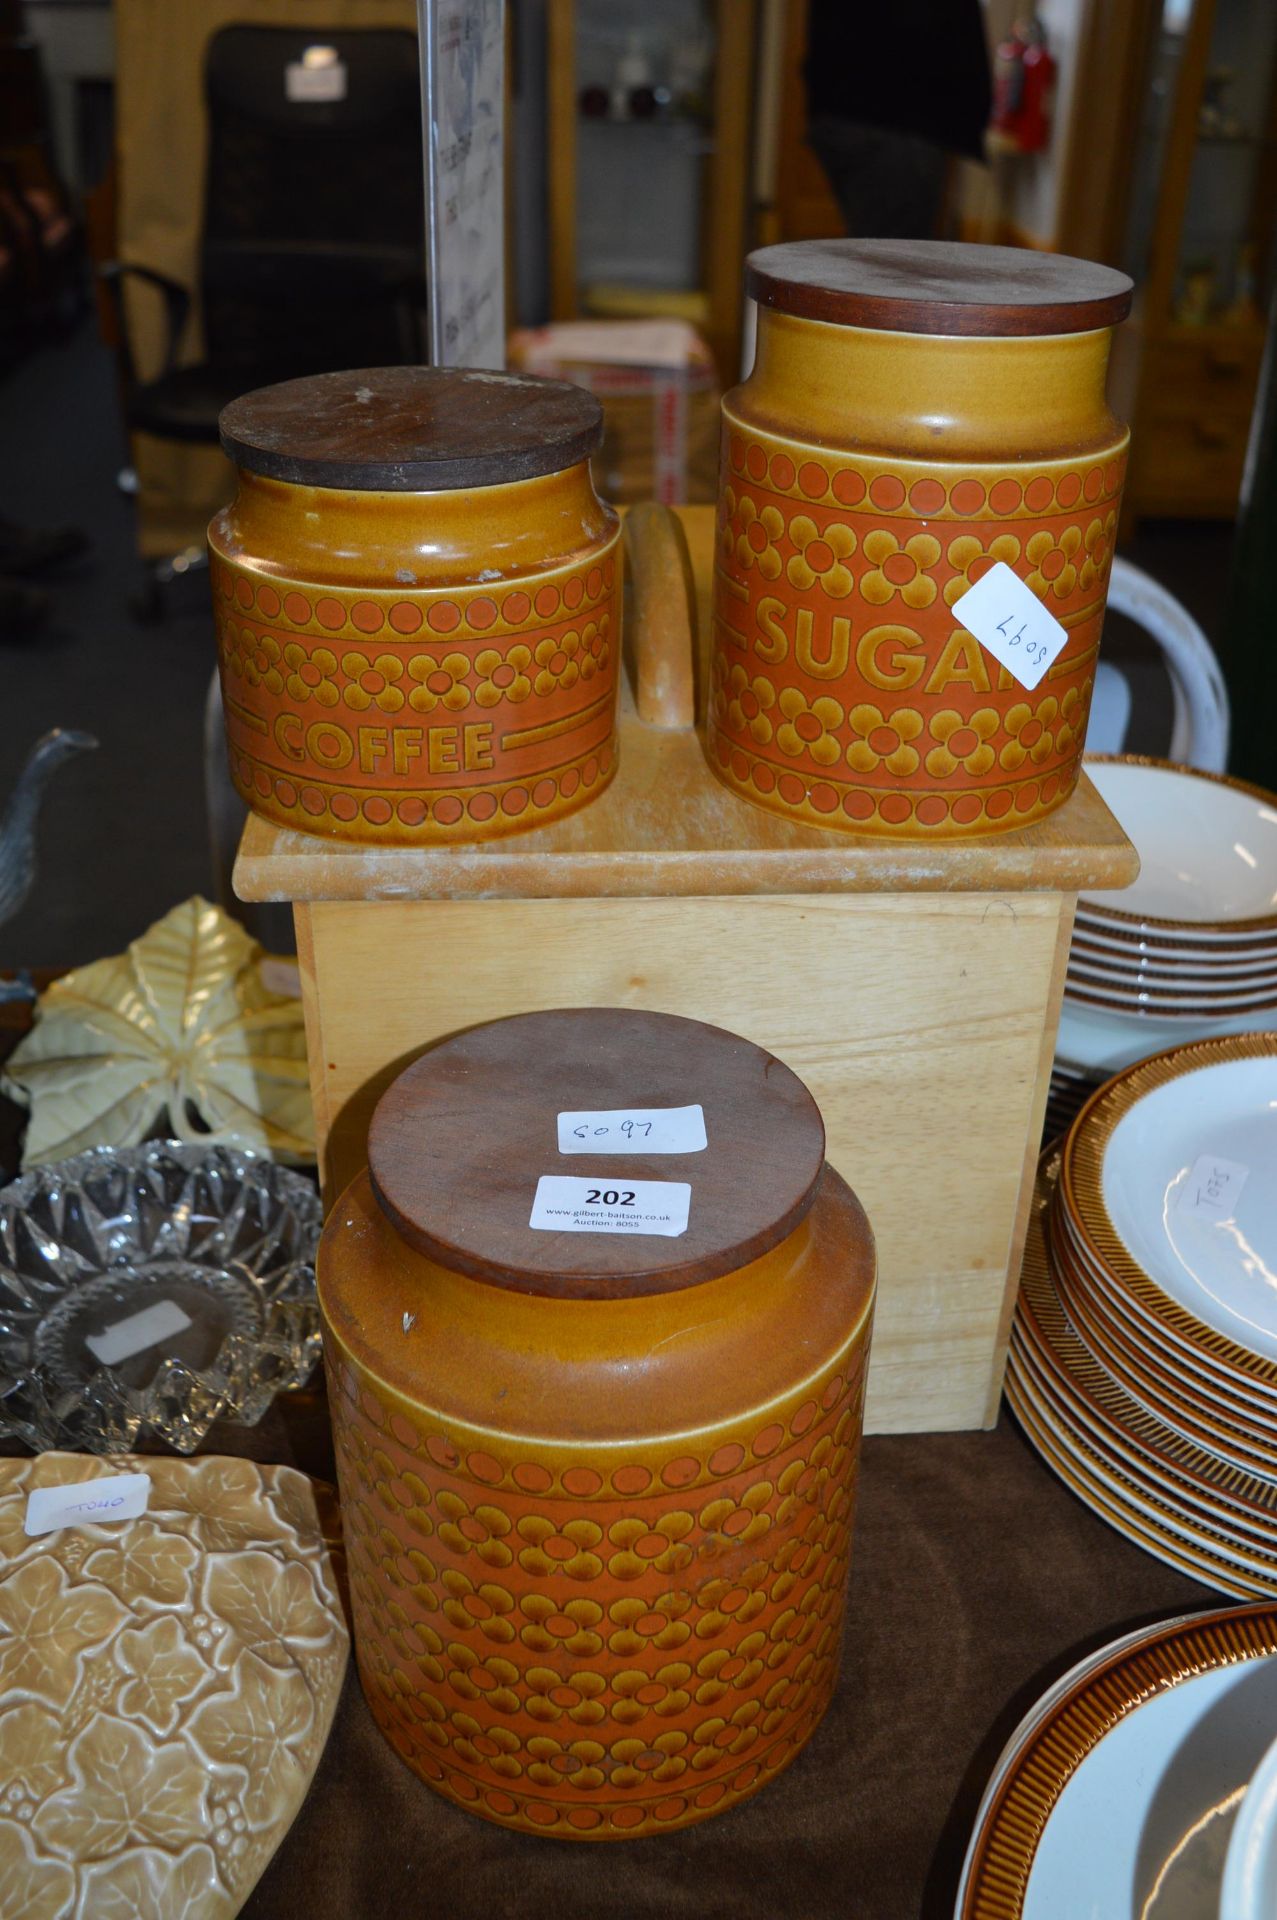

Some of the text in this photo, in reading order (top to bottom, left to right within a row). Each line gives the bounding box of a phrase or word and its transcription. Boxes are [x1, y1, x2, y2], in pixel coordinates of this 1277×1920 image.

[754, 597, 1014, 695] SUGA
[273, 712, 495, 775] COFFEE
[585, 1189, 636, 1207] 202
[546, 1209, 671, 1222] www.gilbert-baitson.co.uk
[573, 1219, 614, 1227] Auction:
